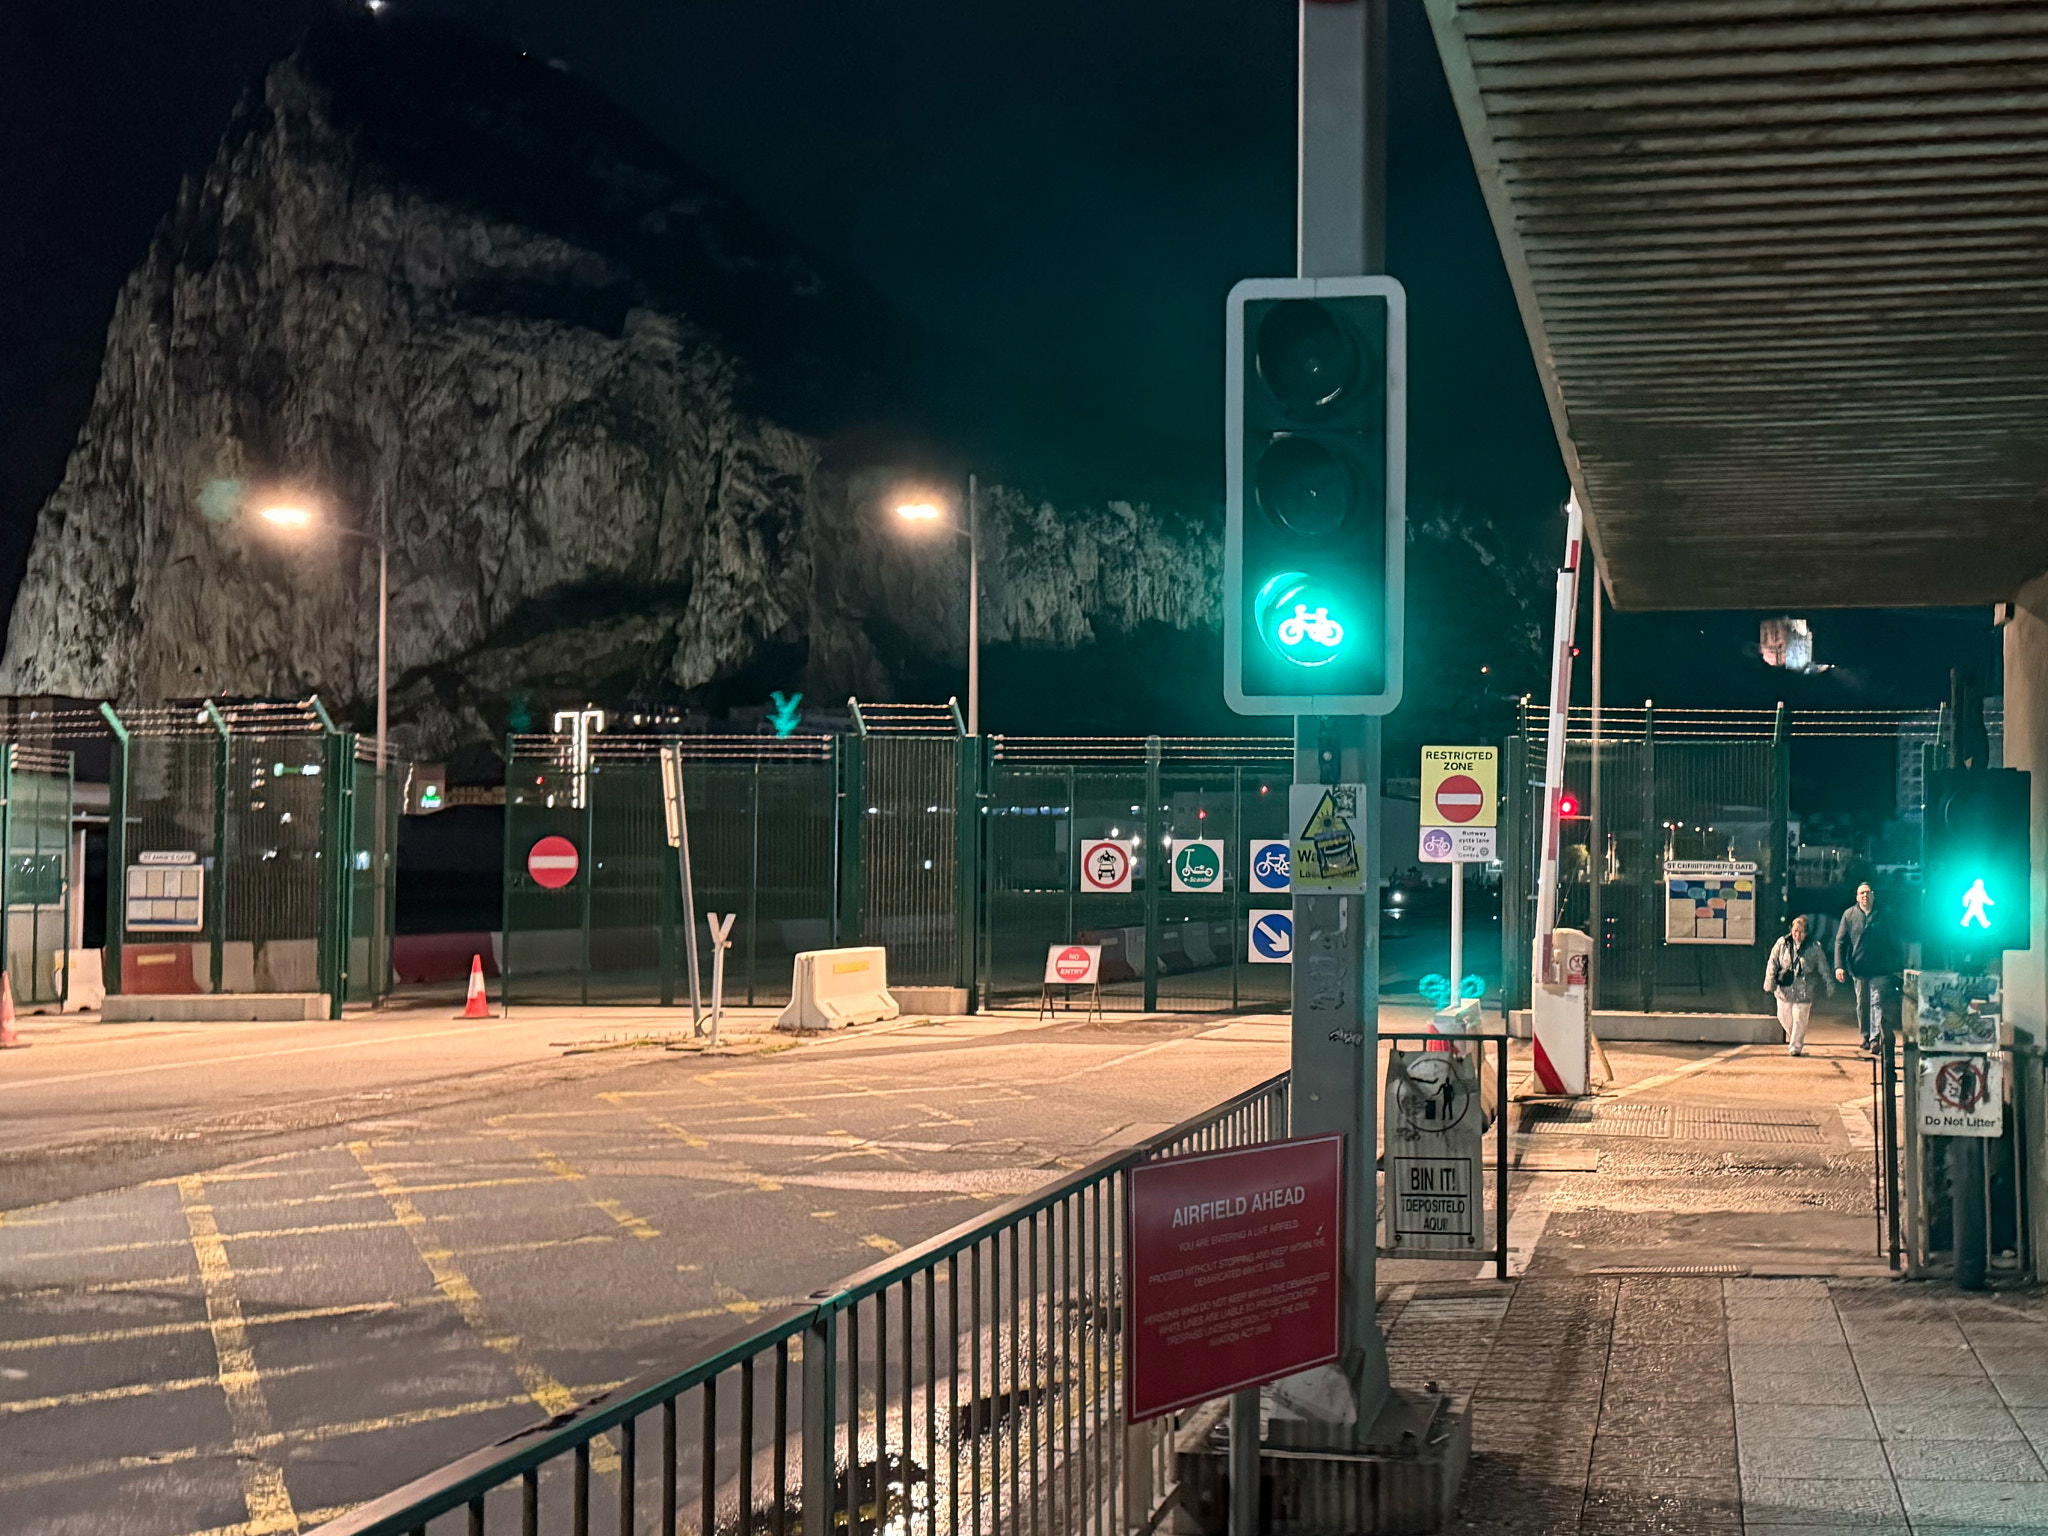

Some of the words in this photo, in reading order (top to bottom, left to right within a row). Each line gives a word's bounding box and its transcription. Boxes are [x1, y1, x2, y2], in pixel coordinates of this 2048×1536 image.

[1426, 751, 1493, 760] RESTRICTED
[1667, 862, 1675, 870] ST
[1060, 968, 1084, 976] ENTRY
[1925, 1116, 1941, 1126] Do
[1944, 1116, 1963, 1126] Not
[1966, 1117, 1997, 1127] Litter
[1411, 1167, 1434, 1191] BIN
[1440, 1167, 1456, 1191] IT!
[1172, 1198, 1248, 1229] AIRFIELD
[1251, 1186, 1306, 1214] AHEAD
